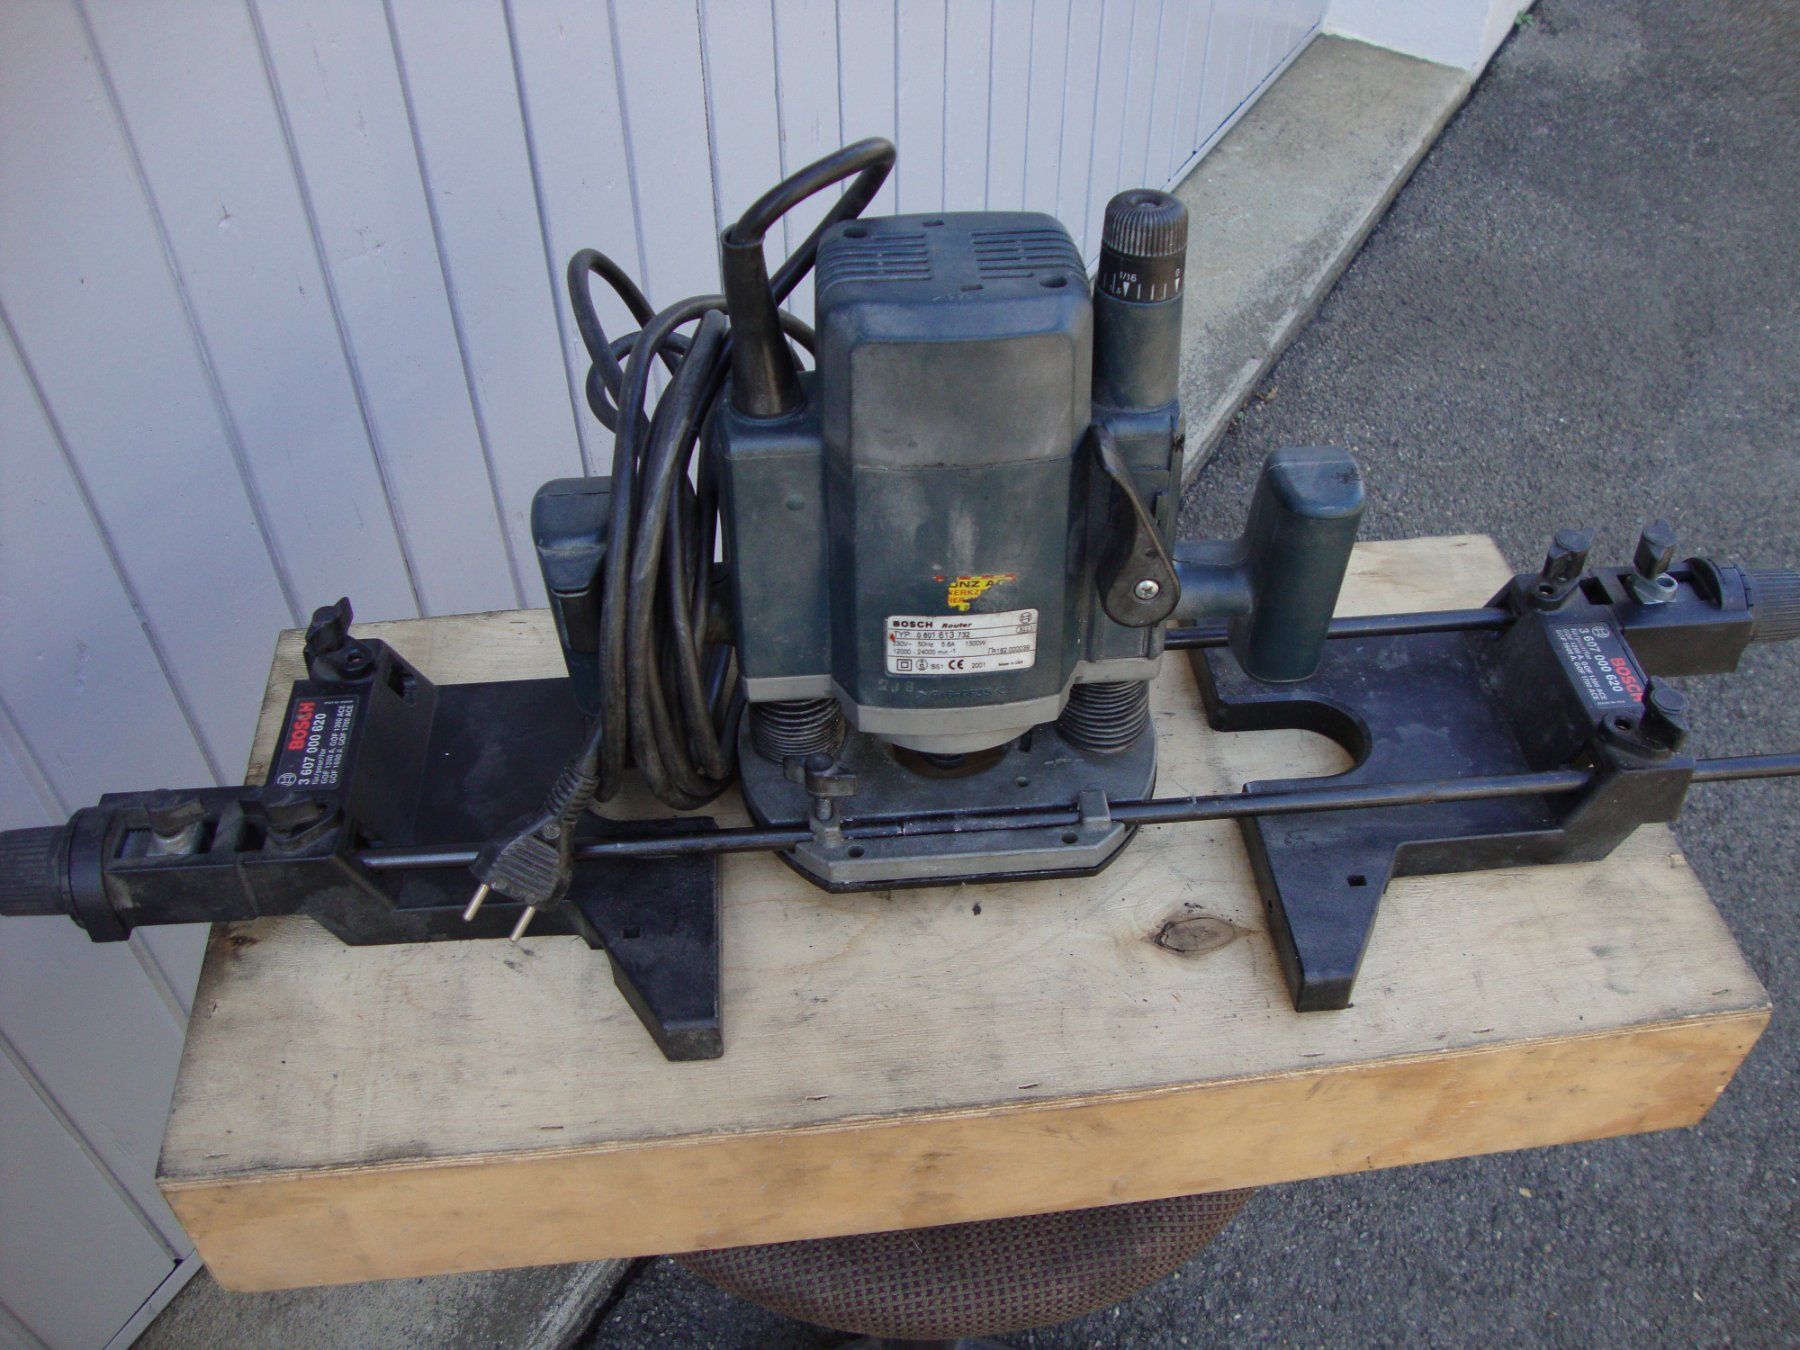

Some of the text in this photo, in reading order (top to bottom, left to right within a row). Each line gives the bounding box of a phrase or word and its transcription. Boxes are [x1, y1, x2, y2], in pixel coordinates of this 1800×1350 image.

[1120, 271, 1137, 282] 1/16
[893, 621, 933, 629] BOSCH
[1583, 635, 1601, 653] 607
[1594, 654, 1612, 673] 000
[1605, 674, 1624, 692] 620
[1596, 688, 1608, 700] ACE
[1610, 657, 1643, 702] BOSCH
[1588, 688, 1600, 701] ACE
[287, 700, 317, 751] BOSCH
[298, 713, 327, 786] 3 607 000 620
